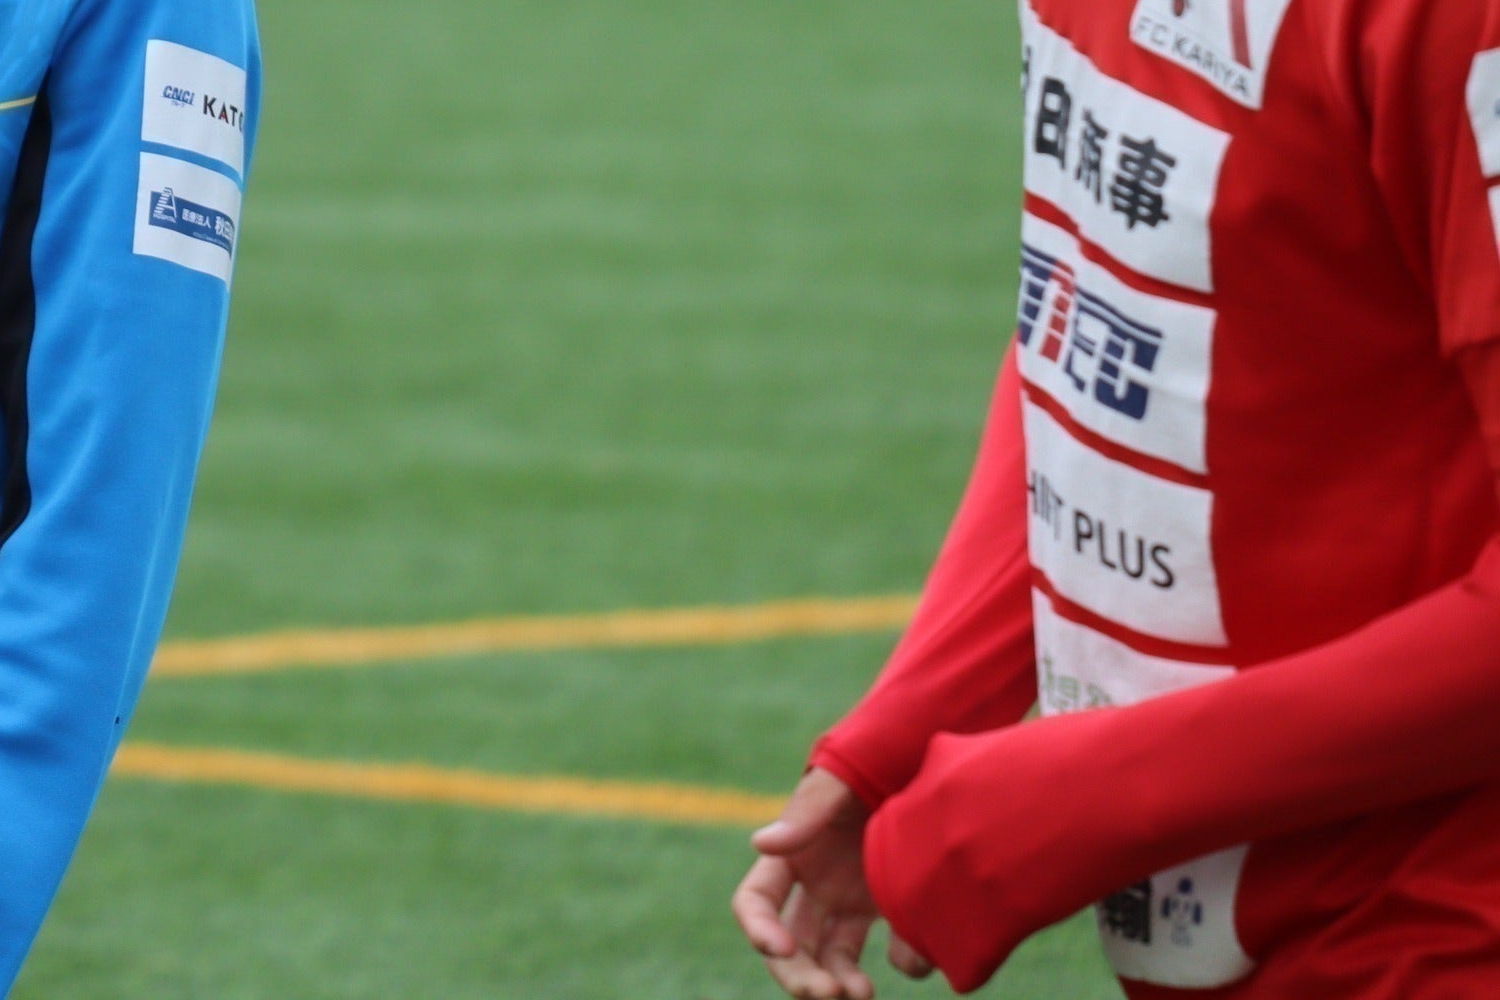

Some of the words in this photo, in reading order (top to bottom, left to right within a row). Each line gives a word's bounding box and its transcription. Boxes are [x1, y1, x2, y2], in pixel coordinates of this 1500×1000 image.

[1134, 16, 1168, 46] FC
[1172, 31, 1250, 97] KARIYA
[1022, 44, 1177, 230] 田商事
[1073, 508, 1175, 588] PLUS
